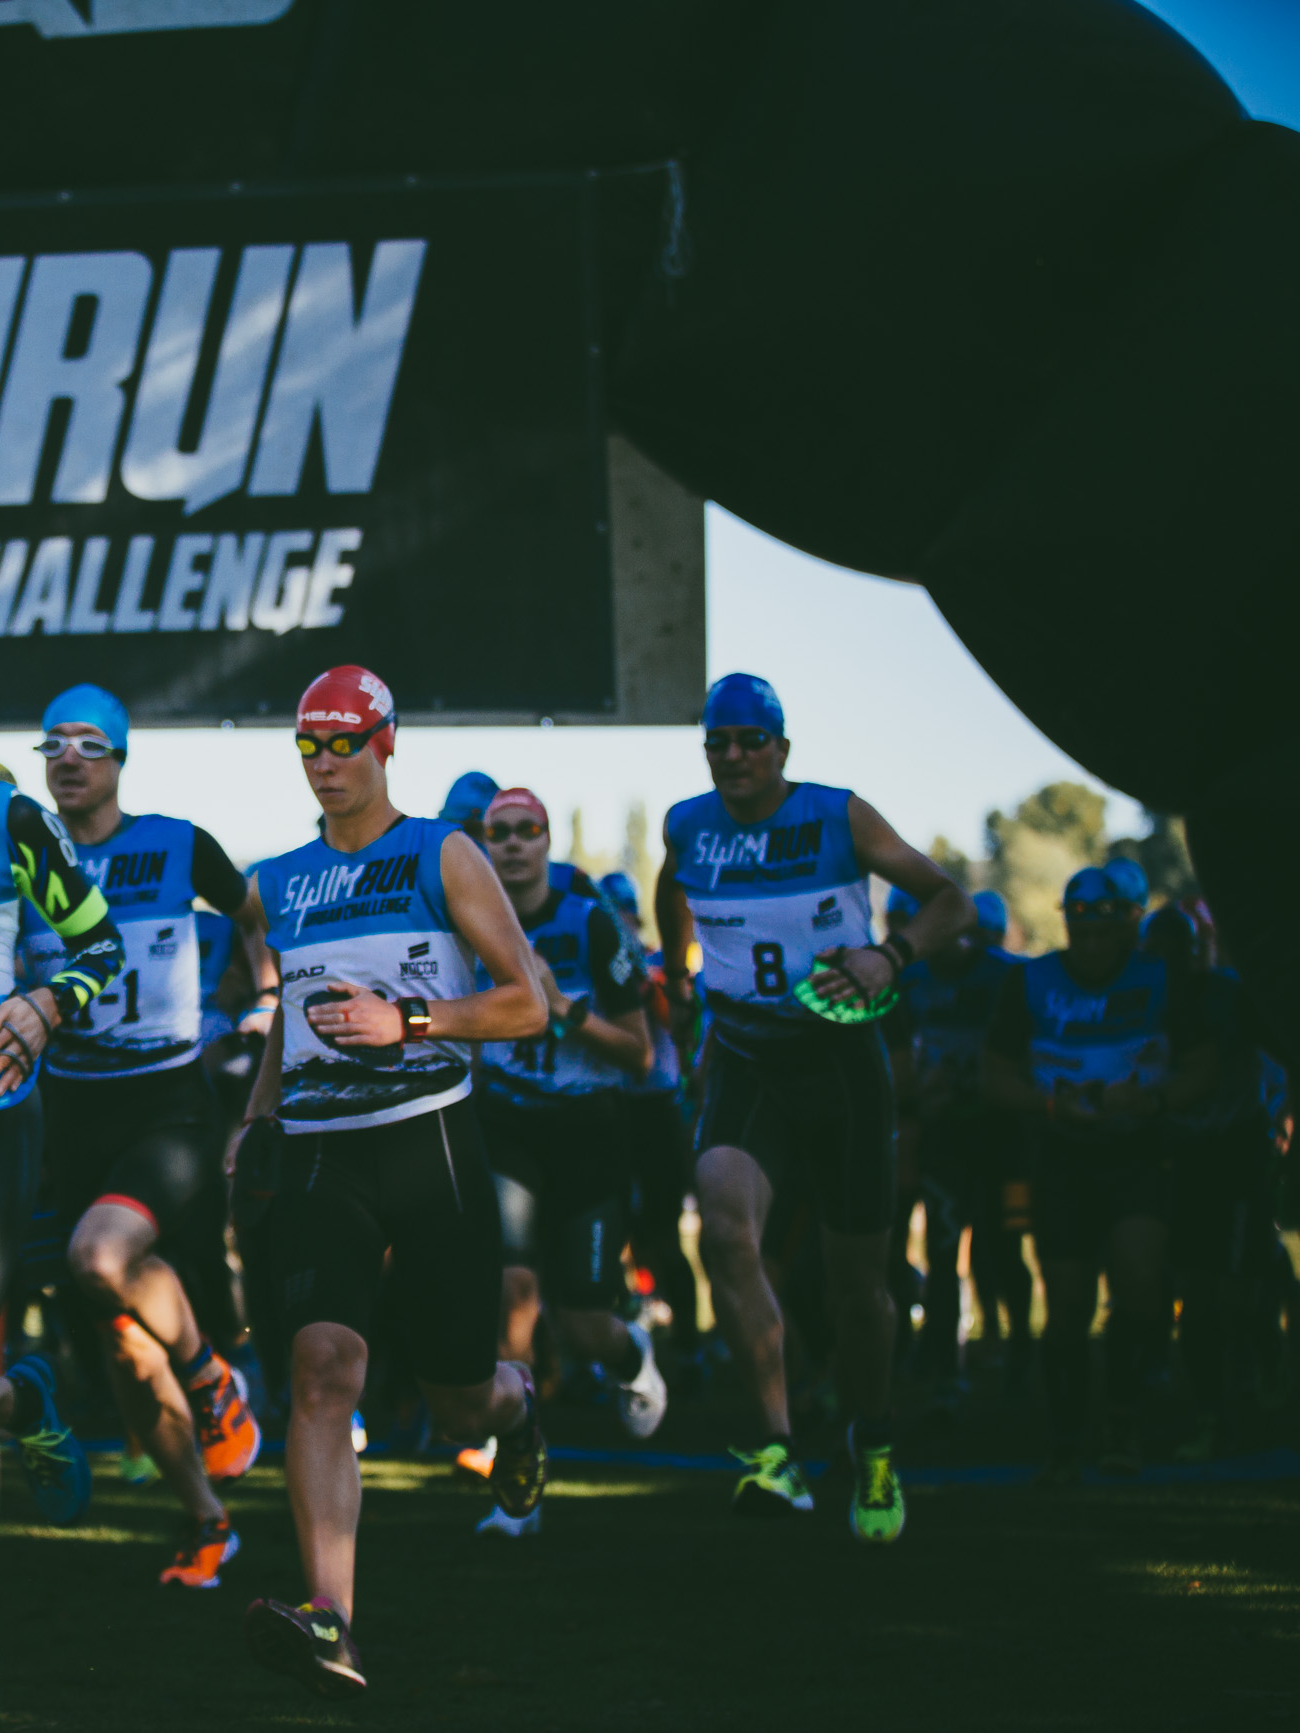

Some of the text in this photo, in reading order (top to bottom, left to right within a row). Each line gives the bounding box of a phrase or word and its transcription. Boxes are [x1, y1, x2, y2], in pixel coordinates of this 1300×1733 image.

[279, 853, 420, 940] SWIMRUN
[282, 965, 326, 982] EAD
[752, 942, 787, 997] 8
